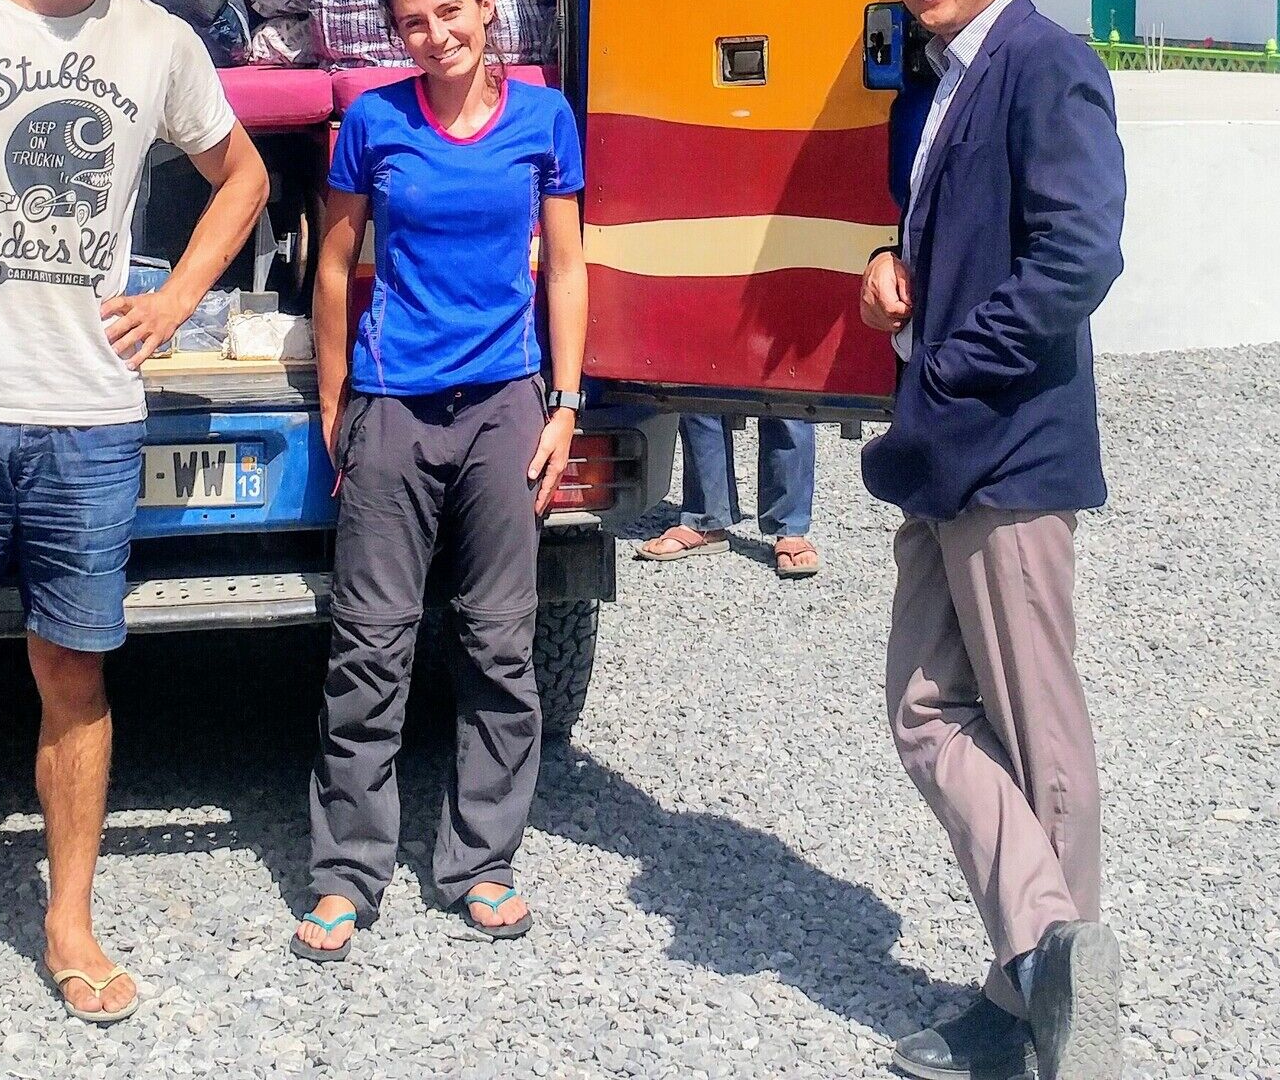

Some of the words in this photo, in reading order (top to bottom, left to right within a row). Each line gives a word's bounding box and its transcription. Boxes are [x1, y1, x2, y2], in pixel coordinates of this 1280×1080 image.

[28, 120, 57, 135] KEEP
[29, 135, 48, 150] ON
[11, 150, 65, 168] TRUCKIN
[55, 273, 85, 285] SINCE
[237, 475, 261, 497] 13
